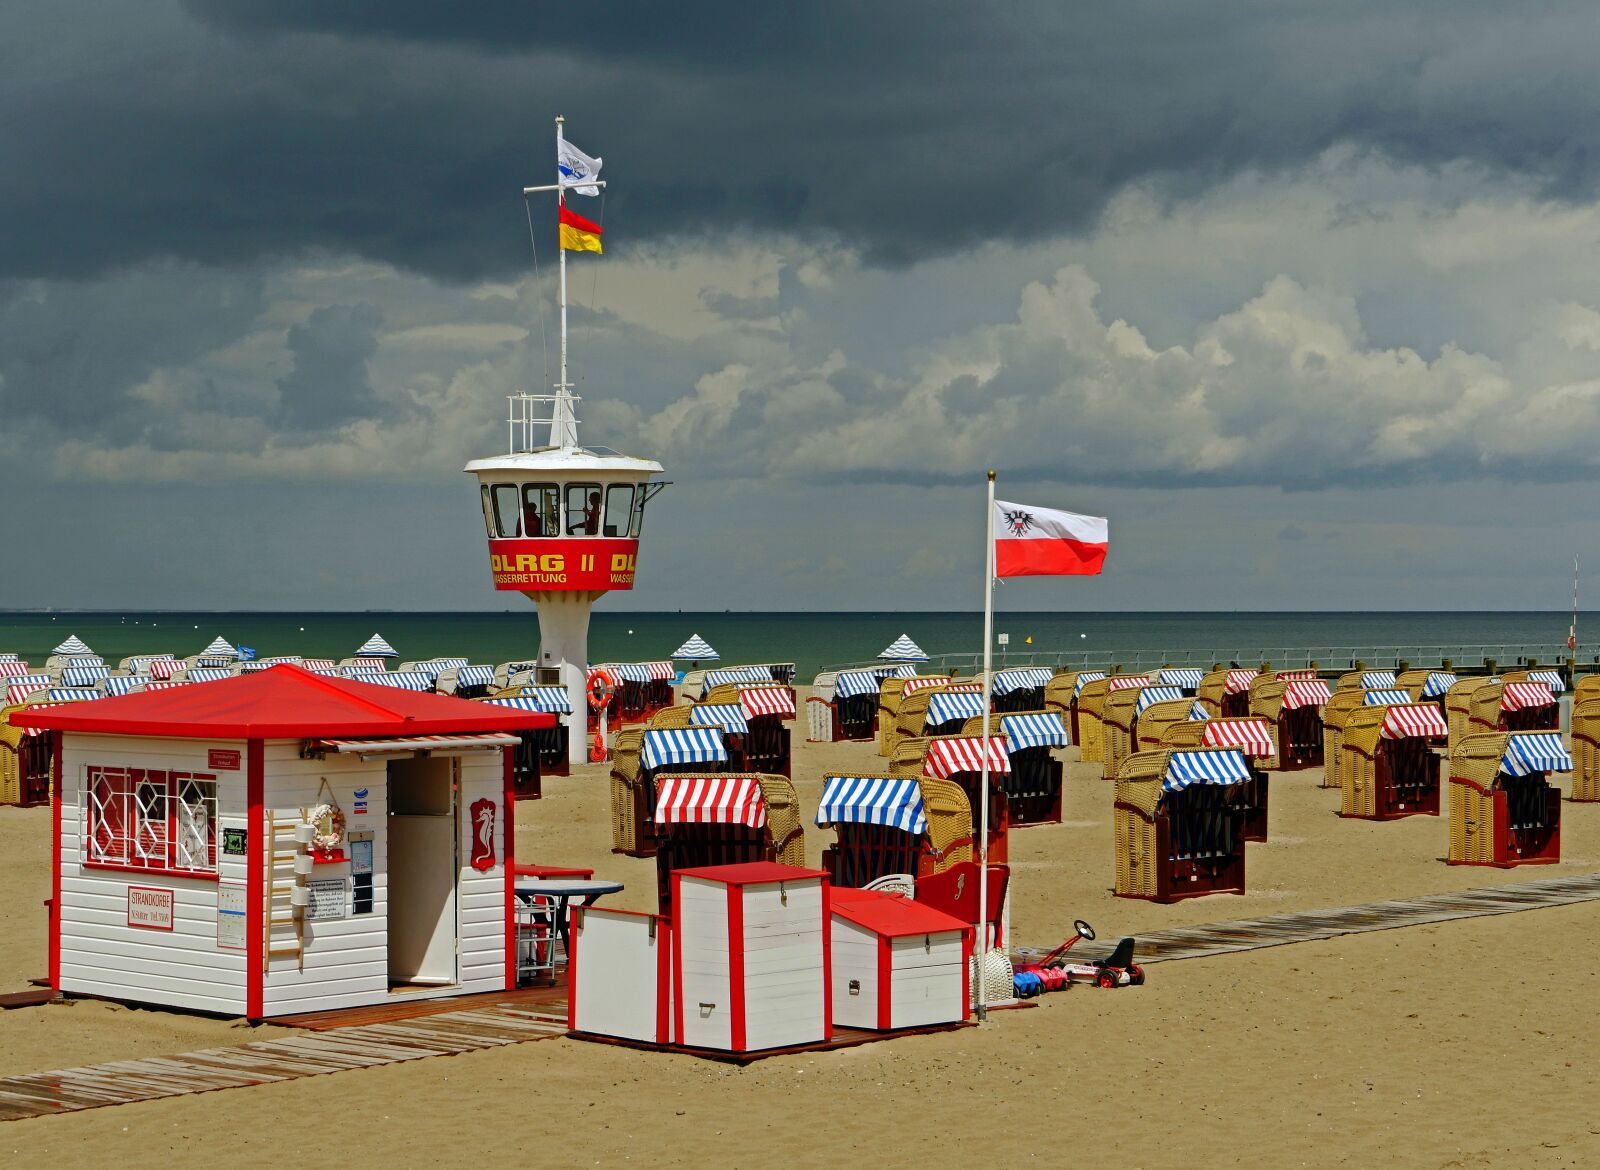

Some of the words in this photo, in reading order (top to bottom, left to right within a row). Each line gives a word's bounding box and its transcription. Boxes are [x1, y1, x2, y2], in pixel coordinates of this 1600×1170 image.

[490, 554, 565, 572] DLRG
[580, 554, 595, 572] II
[495, 573, 567, 583] ASSERRETTUNG
